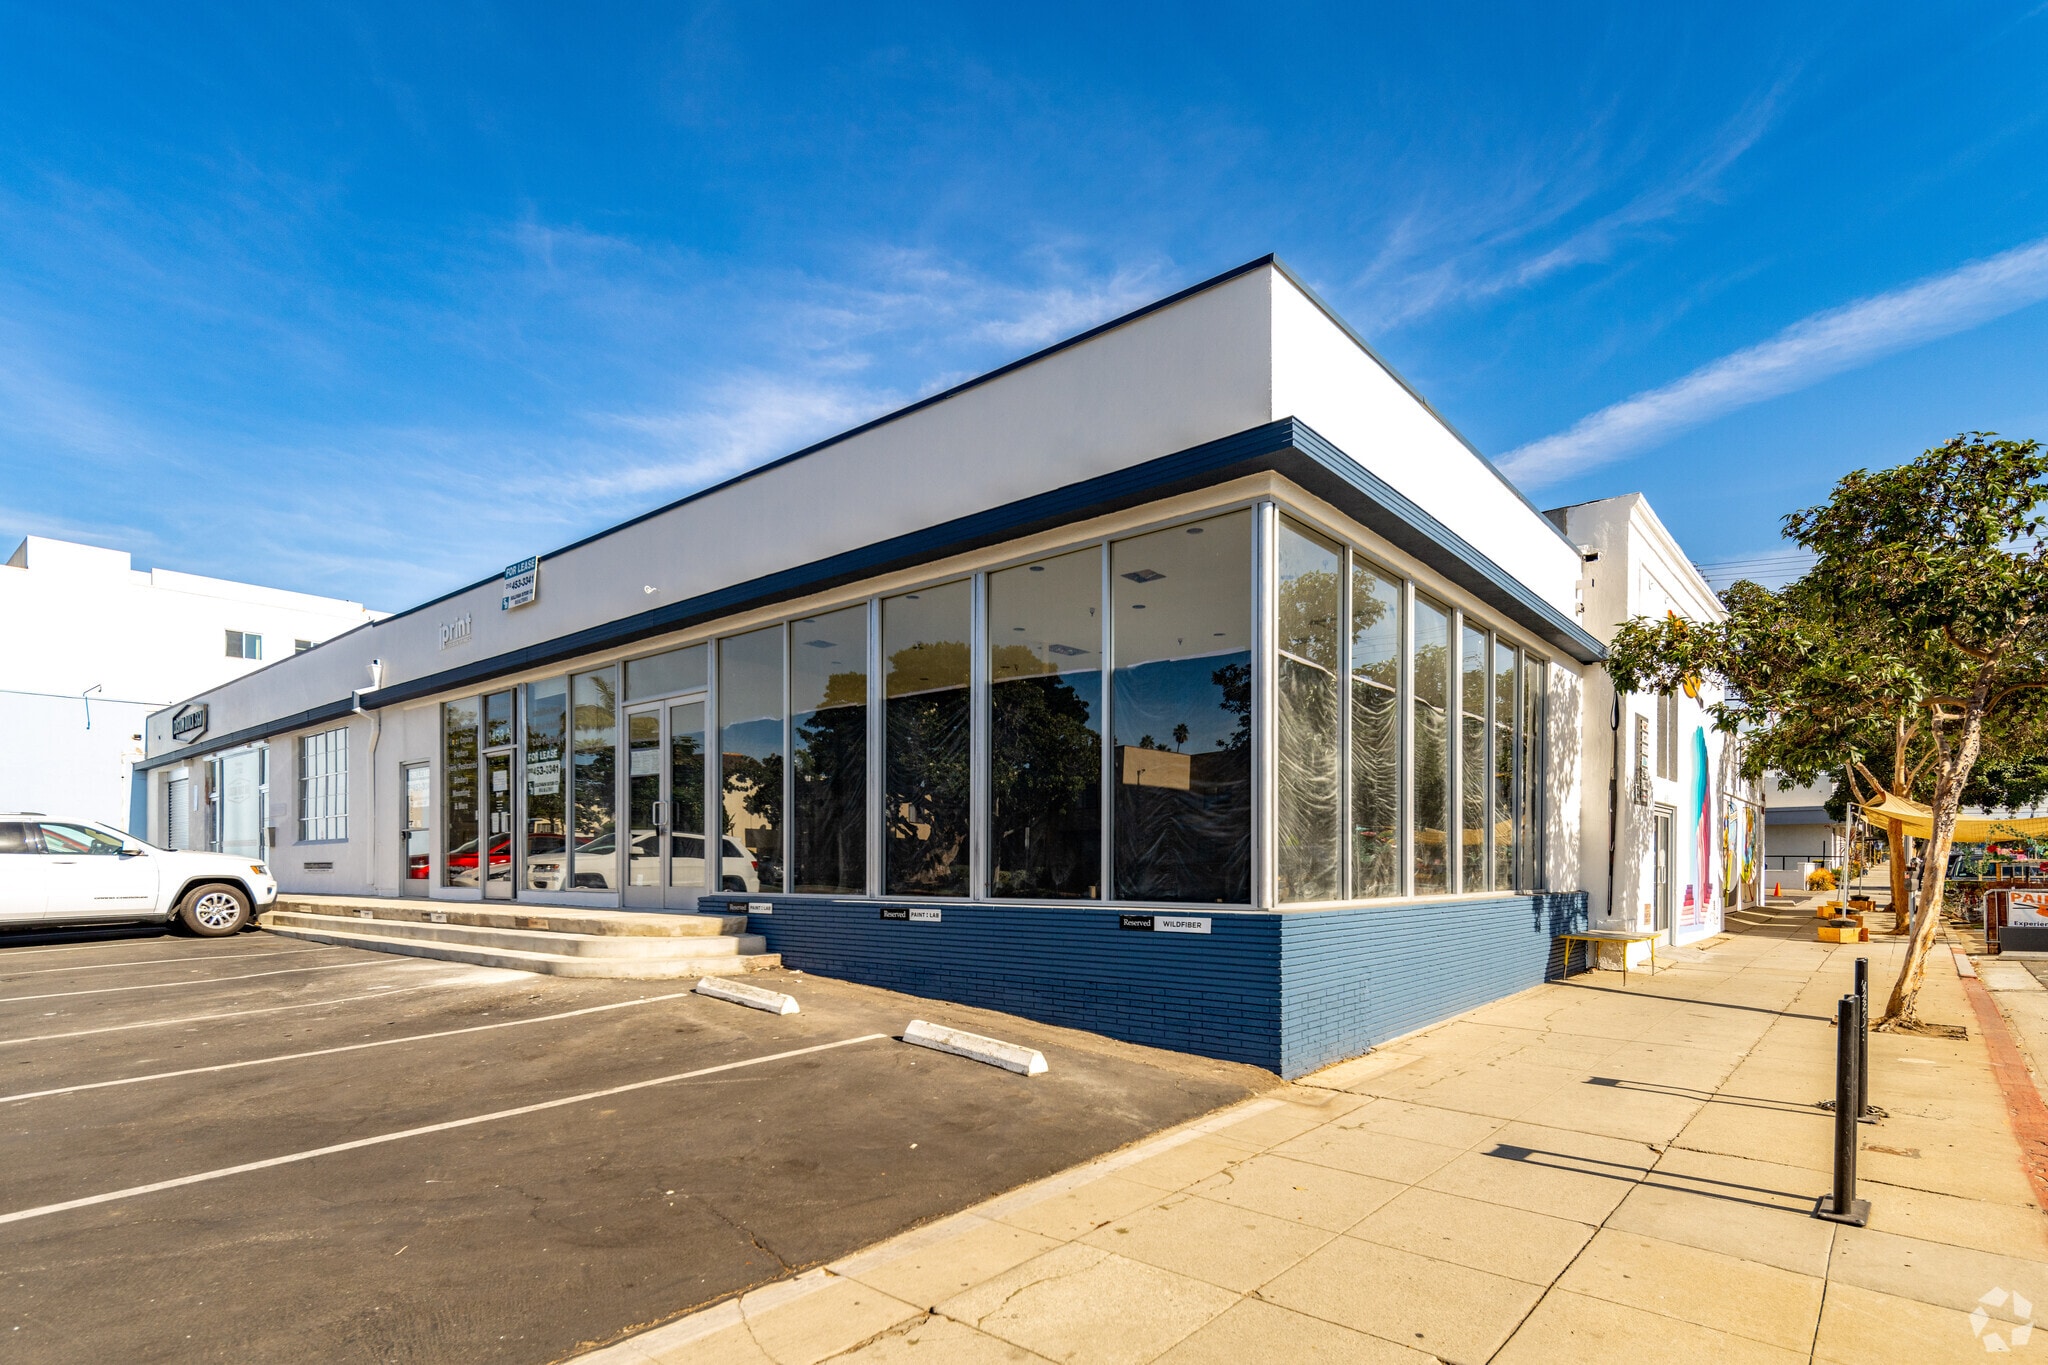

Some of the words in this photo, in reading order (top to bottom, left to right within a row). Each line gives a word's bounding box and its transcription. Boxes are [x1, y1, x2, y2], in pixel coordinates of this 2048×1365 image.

[506, 566, 516, 577] FOR
[518, 559, 535, 572] LEASE
[528, 752, 538, 761] FOR
[540, 748, 558, 760] LEASE
[884, 910, 906, 918] Reserved
[1123, 919, 1151, 927] Reserved
[1163, 920, 1202, 929] WILDFIBER
